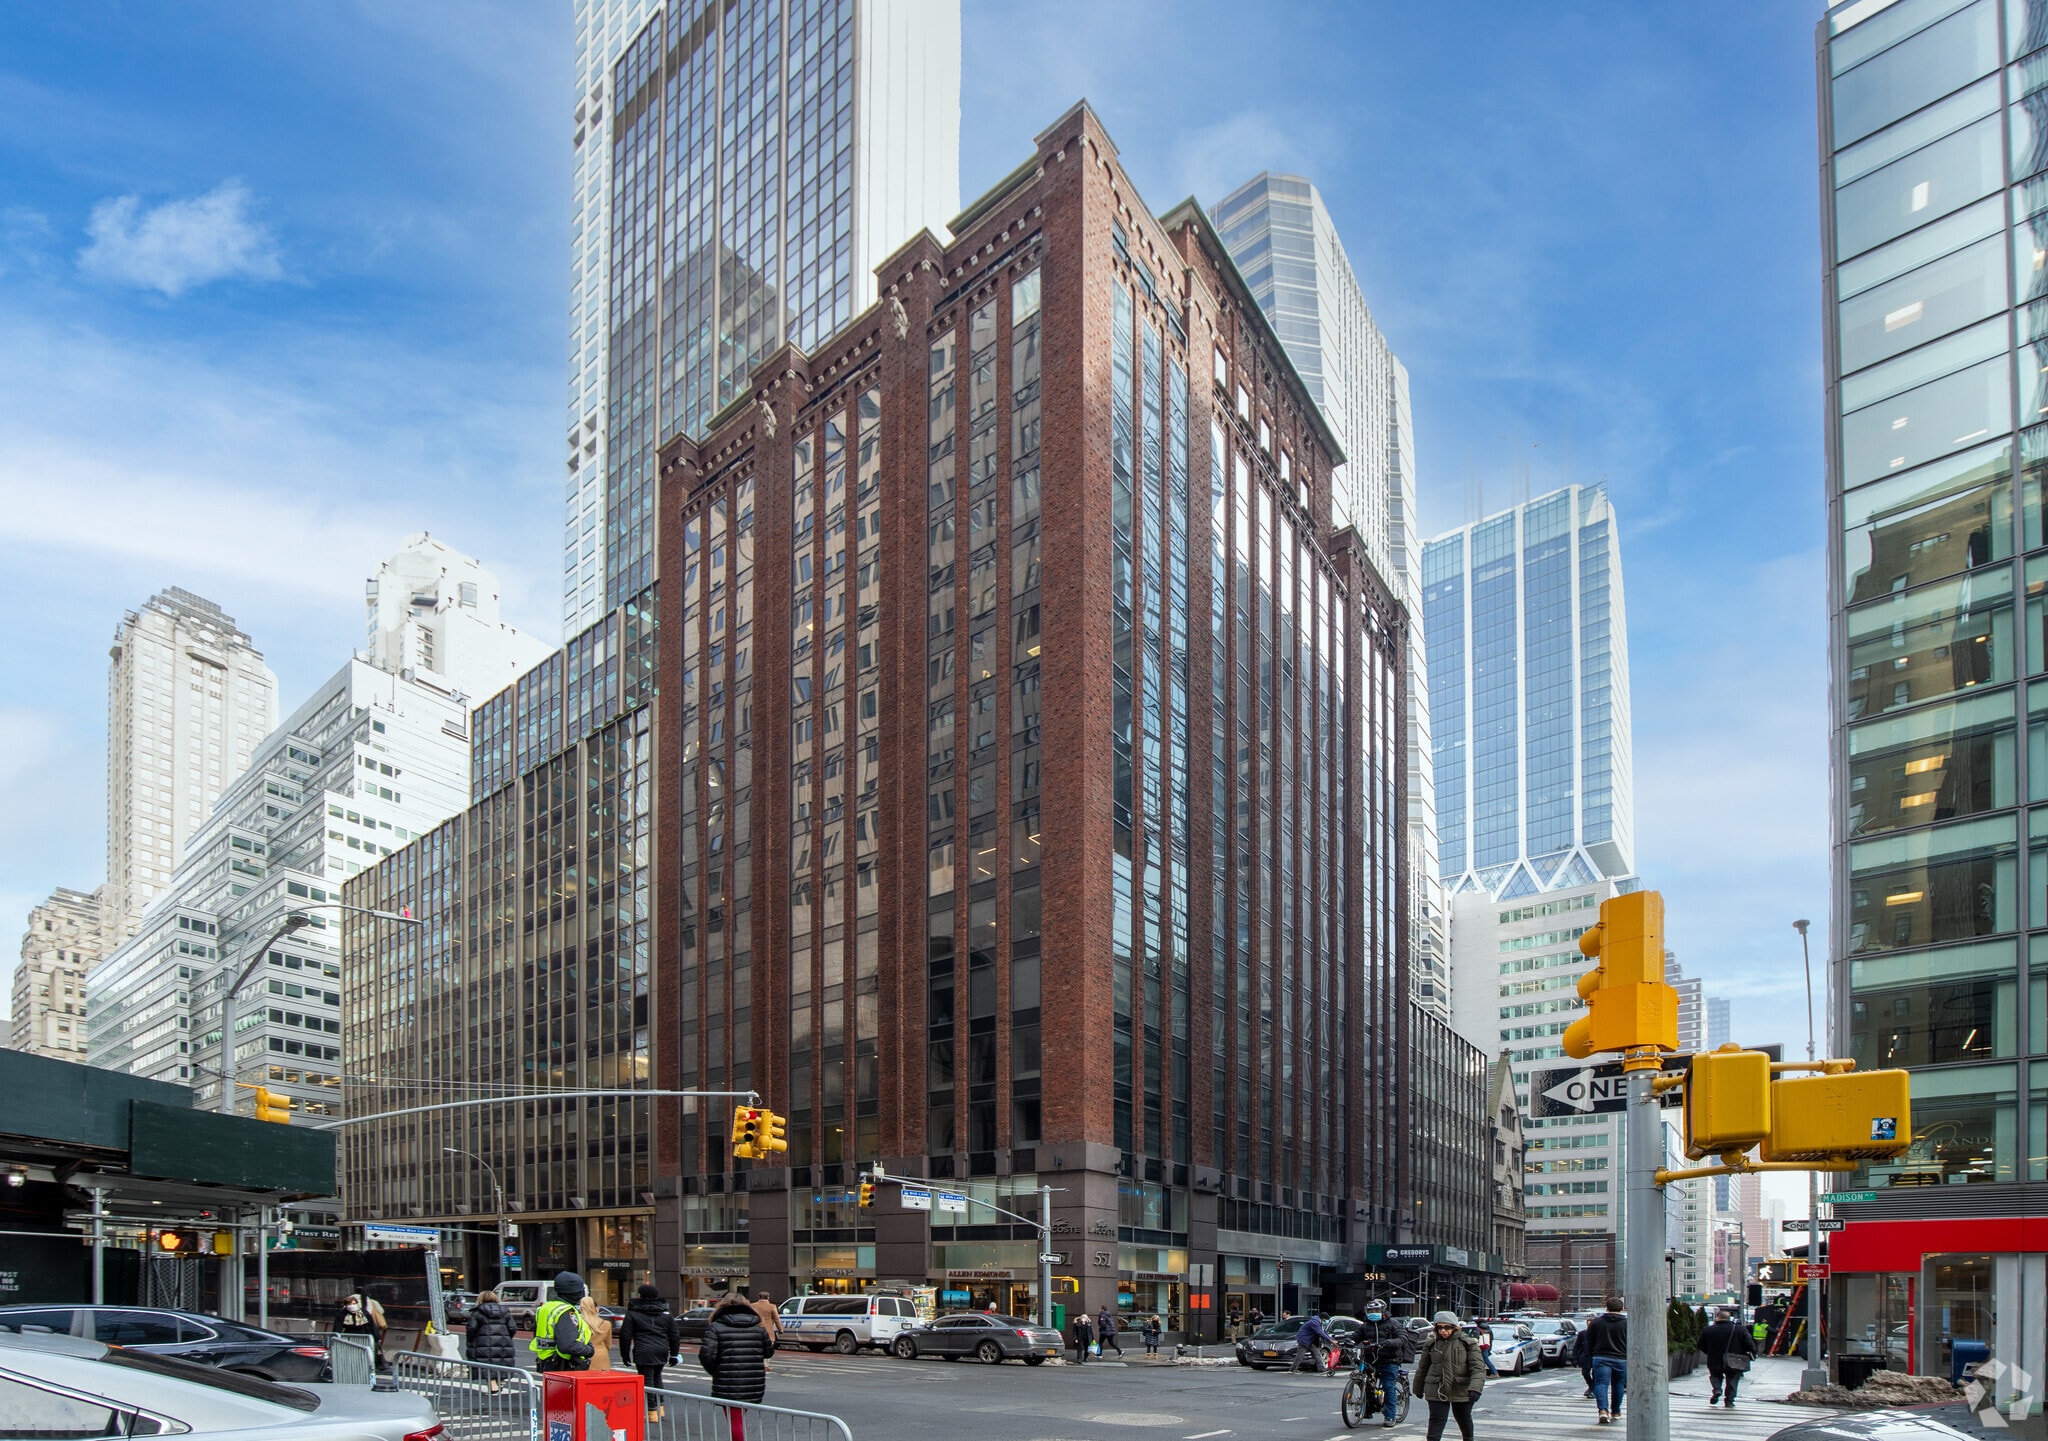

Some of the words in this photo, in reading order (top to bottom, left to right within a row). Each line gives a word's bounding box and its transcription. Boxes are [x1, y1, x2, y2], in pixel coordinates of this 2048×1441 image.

[1566, 1078, 1627, 1101] ONE
[1823, 1193, 1864, 1202] MADISON
[294, 1229, 319, 1237] FIRST
[1051, 1226, 1081, 1234] COSTE
[1092, 1250, 1113, 1268] 551
[948, 1270, 973, 1278] ALLEN
[973, 1270, 1012, 1278] EDMONDS
[1136, 1272, 1154, 1280] ALLEN
[1154, 1273, 1179, 1281] EDMONDS
